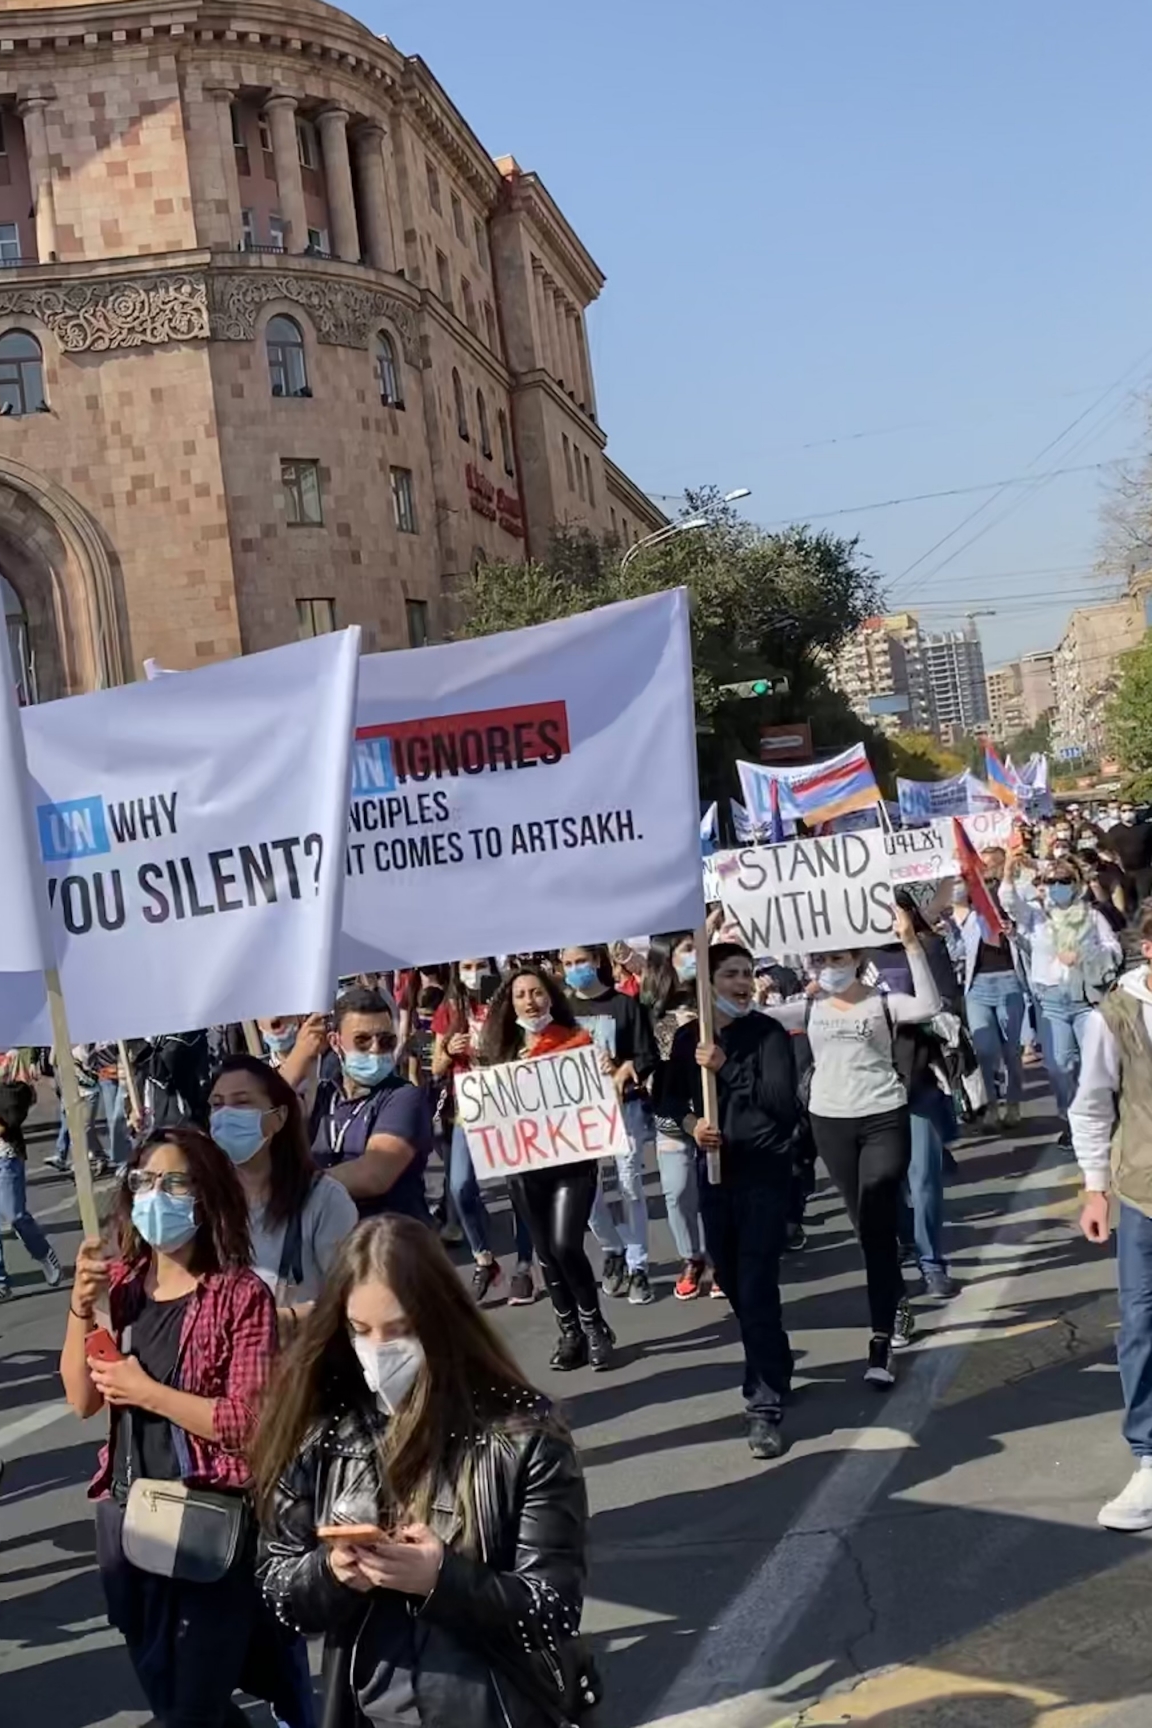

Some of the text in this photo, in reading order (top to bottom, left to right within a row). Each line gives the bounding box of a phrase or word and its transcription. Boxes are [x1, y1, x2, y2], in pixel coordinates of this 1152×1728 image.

[393, 719, 564, 785] IGNORES
[49, 791, 178, 854] UN WHY
[374, 832, 464, 872] COMES
[468, 827, 503, 860] TO
[510, 809, 644, 855] ARTSAKH.
[137, 832, 324, 923] SILENT?
[737, 834, 871, 891] STAND
[727, 882, 896, 950] WITH US
[460, 1049, 606, 1123] SANCTION
[468, 1103, 618, 1169] TURKEY
